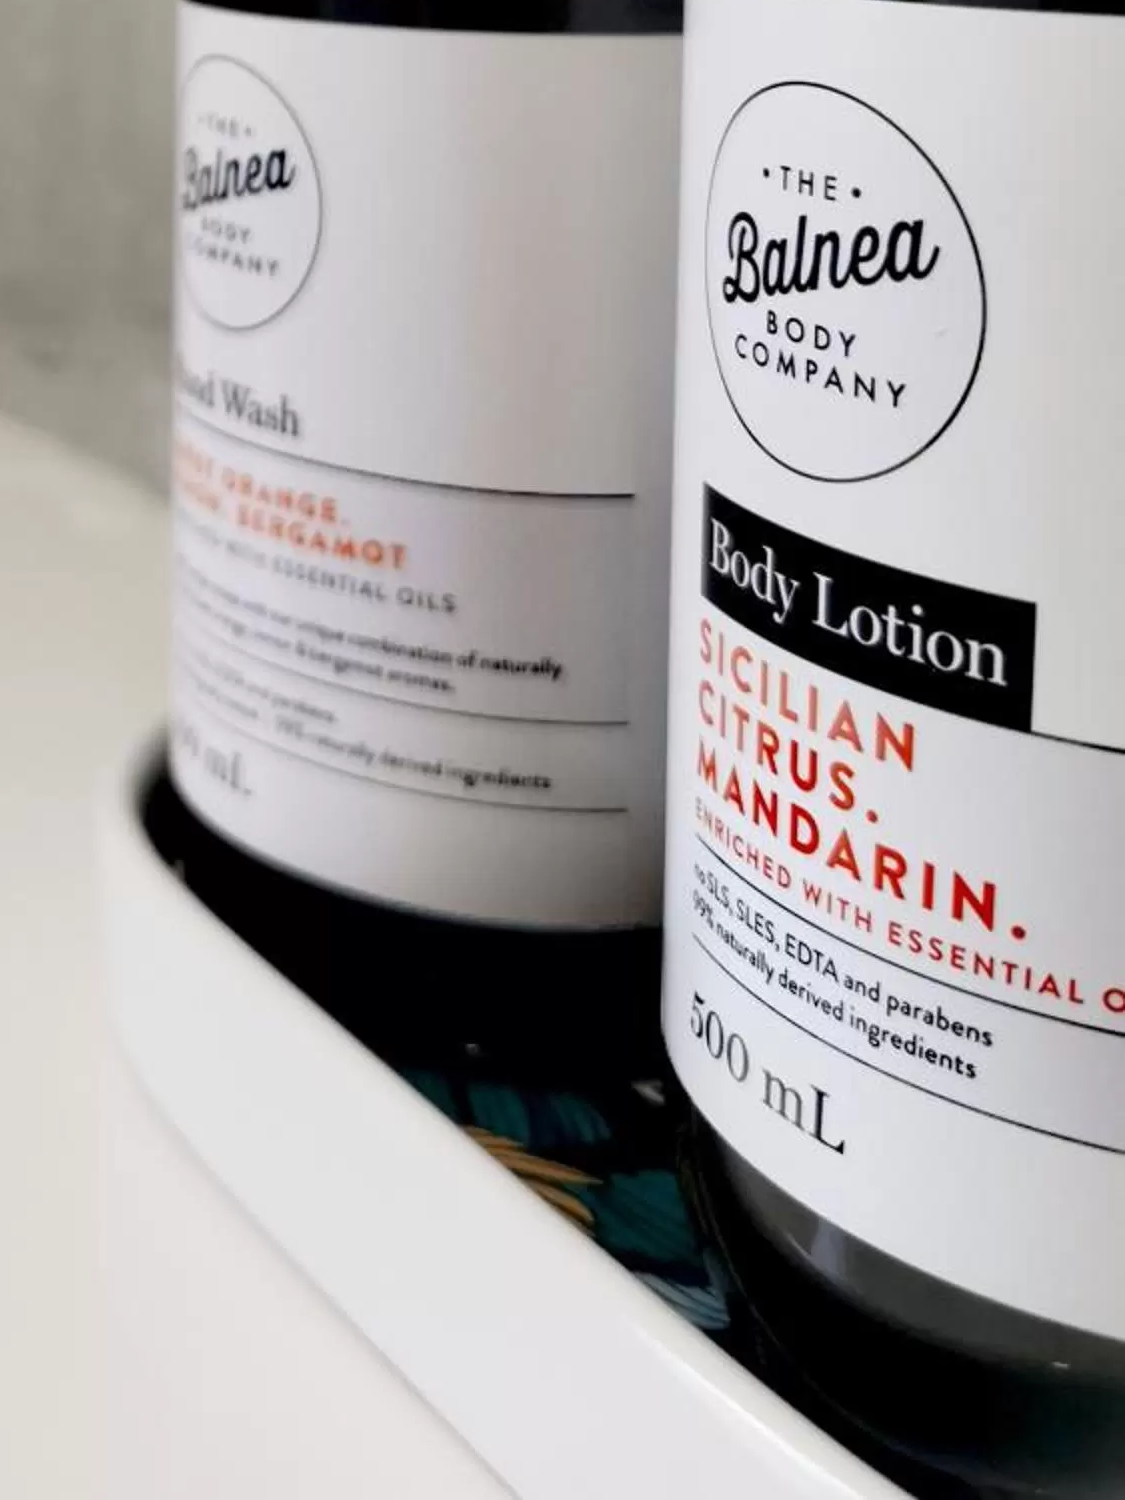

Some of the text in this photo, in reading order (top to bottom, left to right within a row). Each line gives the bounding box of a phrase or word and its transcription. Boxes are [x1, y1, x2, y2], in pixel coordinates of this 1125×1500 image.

[181, 145, 298, 212] Balnea
[780, 166, 838, 201] THE
[722, 211, 940, 303] Balnea
[734, 333, 906, 408] COMPANY
[765, 309, 856, 358] BODY
[220, 376, 300, 439] Wash
[236, 500, 409, 571] BERGAMOT
[271, 553, 387, 604] ESSENTIAL
[395, 585, 458, 615] OILS
[709, 517, 1008, 687] Body Lotion
[456, 649, 480, 671] of
[479, 653, 565, 683] naturally
[698, 617, 916, 773] SICILIAN
[697, 678, 880, 824] CITRUS.
[696, 731, 1028, 942] MANDARIN.
[694, 796, 793, 891] ENRICHED
[801, 876, 874, 934] WITH
[887, 920, 1085, 1005] ESSENTIAL
[707, 870, 735, 917] SLS,
[736, 895, 780, 953] SLES,
[784, 933, 841, 985] EDTA
[843, 970, 881, 1004] and
[886, 991, 994, 1049] parabens
[715, 919, 777, 987] naturally
[777, 967, 845, 1024] derived
[849, 1002, 979, 1081] ingredients
[688, 989, 847, 1157] 500 mL
